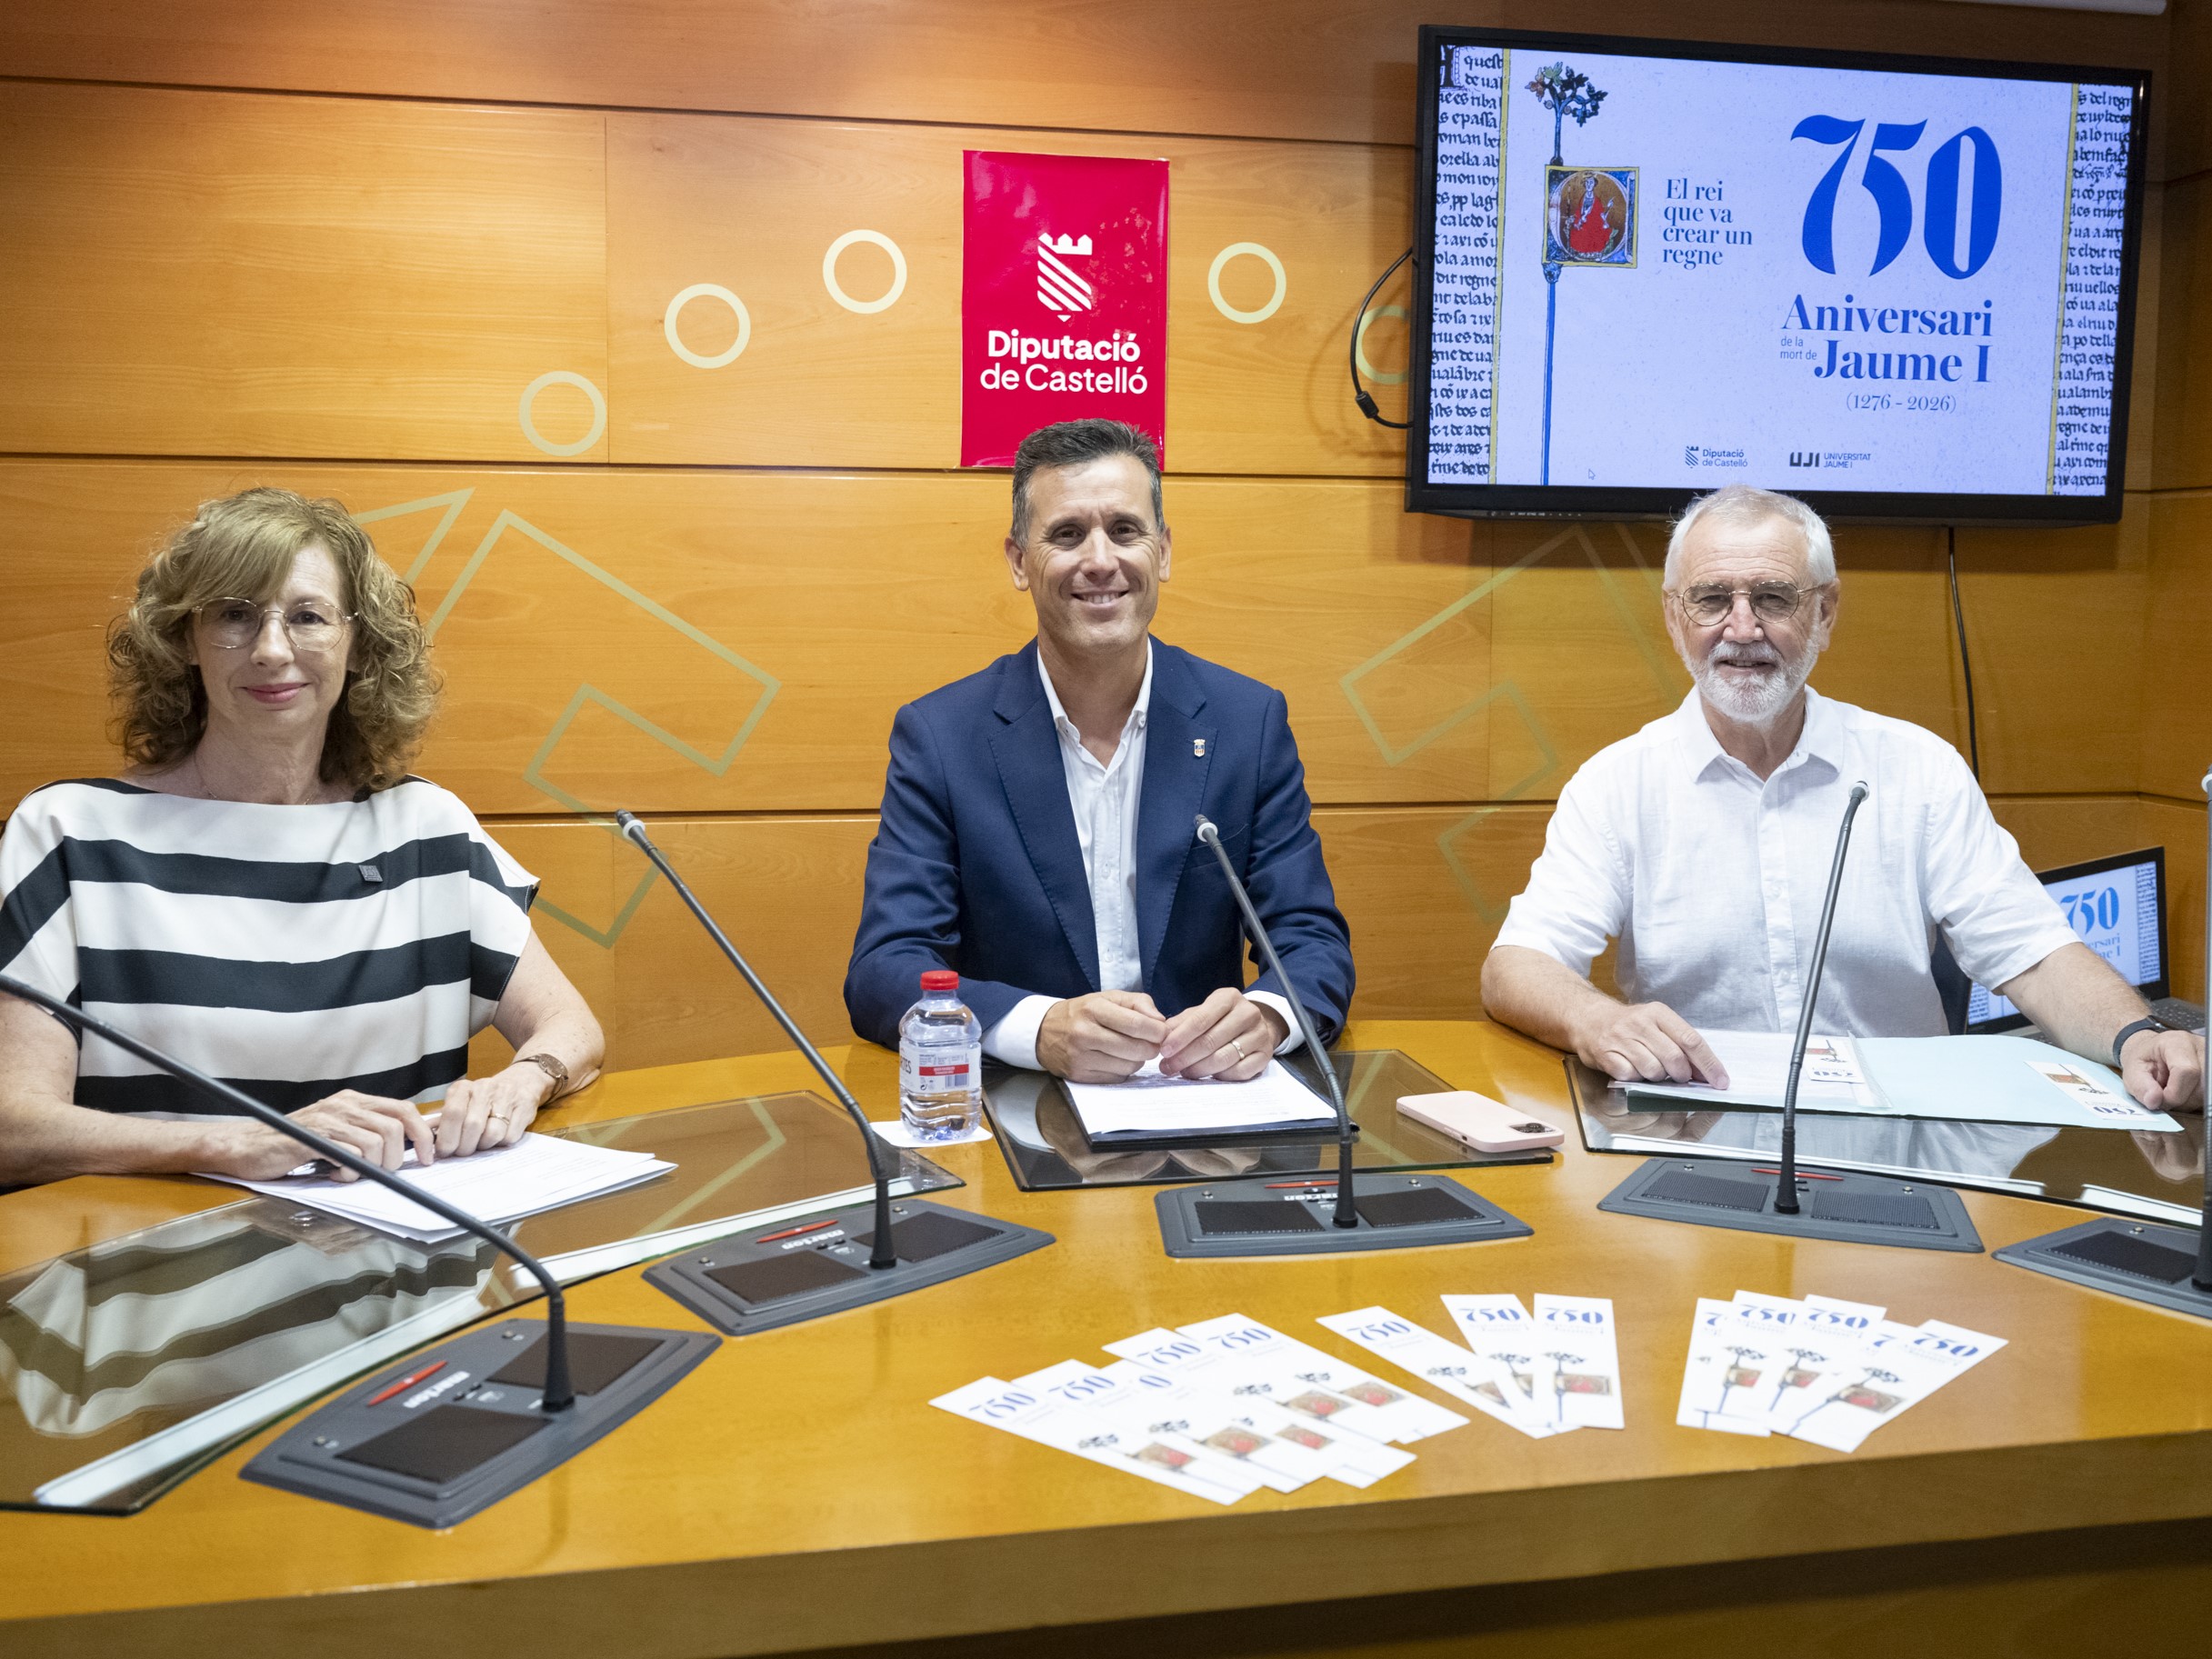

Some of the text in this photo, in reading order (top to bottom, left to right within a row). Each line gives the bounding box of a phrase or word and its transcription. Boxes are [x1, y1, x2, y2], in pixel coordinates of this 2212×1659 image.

[1666, 178, 1724, 201] El rei
[1791, 114, 2002, 280] 750
[1664, 205, 1734, 227] que va
[1663, 227, 1753, 245] crear un
[1662, 248, 1724, 271] regne
[1780, 294, 1994, 336] Aniversari
[988, 329, 1140, 364] Diputació
[1780, 335, 1804, 347] de la
[1779, 350, 1817, 360] mort de
[1814, 339, 1994, 383] Jaume I
[980, 363, 1148, 395] de Castelló
[1846, 391, 1891, 412] (1276
[1907, 394, 1957, 415] 2026)
[1702, 448, 1745, 459] Diputació
[1702, 458, 1748, 467] de Castelló
[1824, 453, 1871, 461] UNIVERSITAT
[2060, 886, 2119, 934] 750
[1458, 1306, 1521, 1323] 750
[1543, 1306, 1605, 1324] 750
[1807, 1306, 1870, 1329] 750
[1206, 1326, 1274, 1351] 750
[1346, 1320, 1411, 1341] 750
[1136, 1341, 1202, 1364] 750
[1913, 1332, 1980, 1358] 750
[1047, 1374, 1117, 1402] 750
[967, 1391, 1037, 1419] 750
